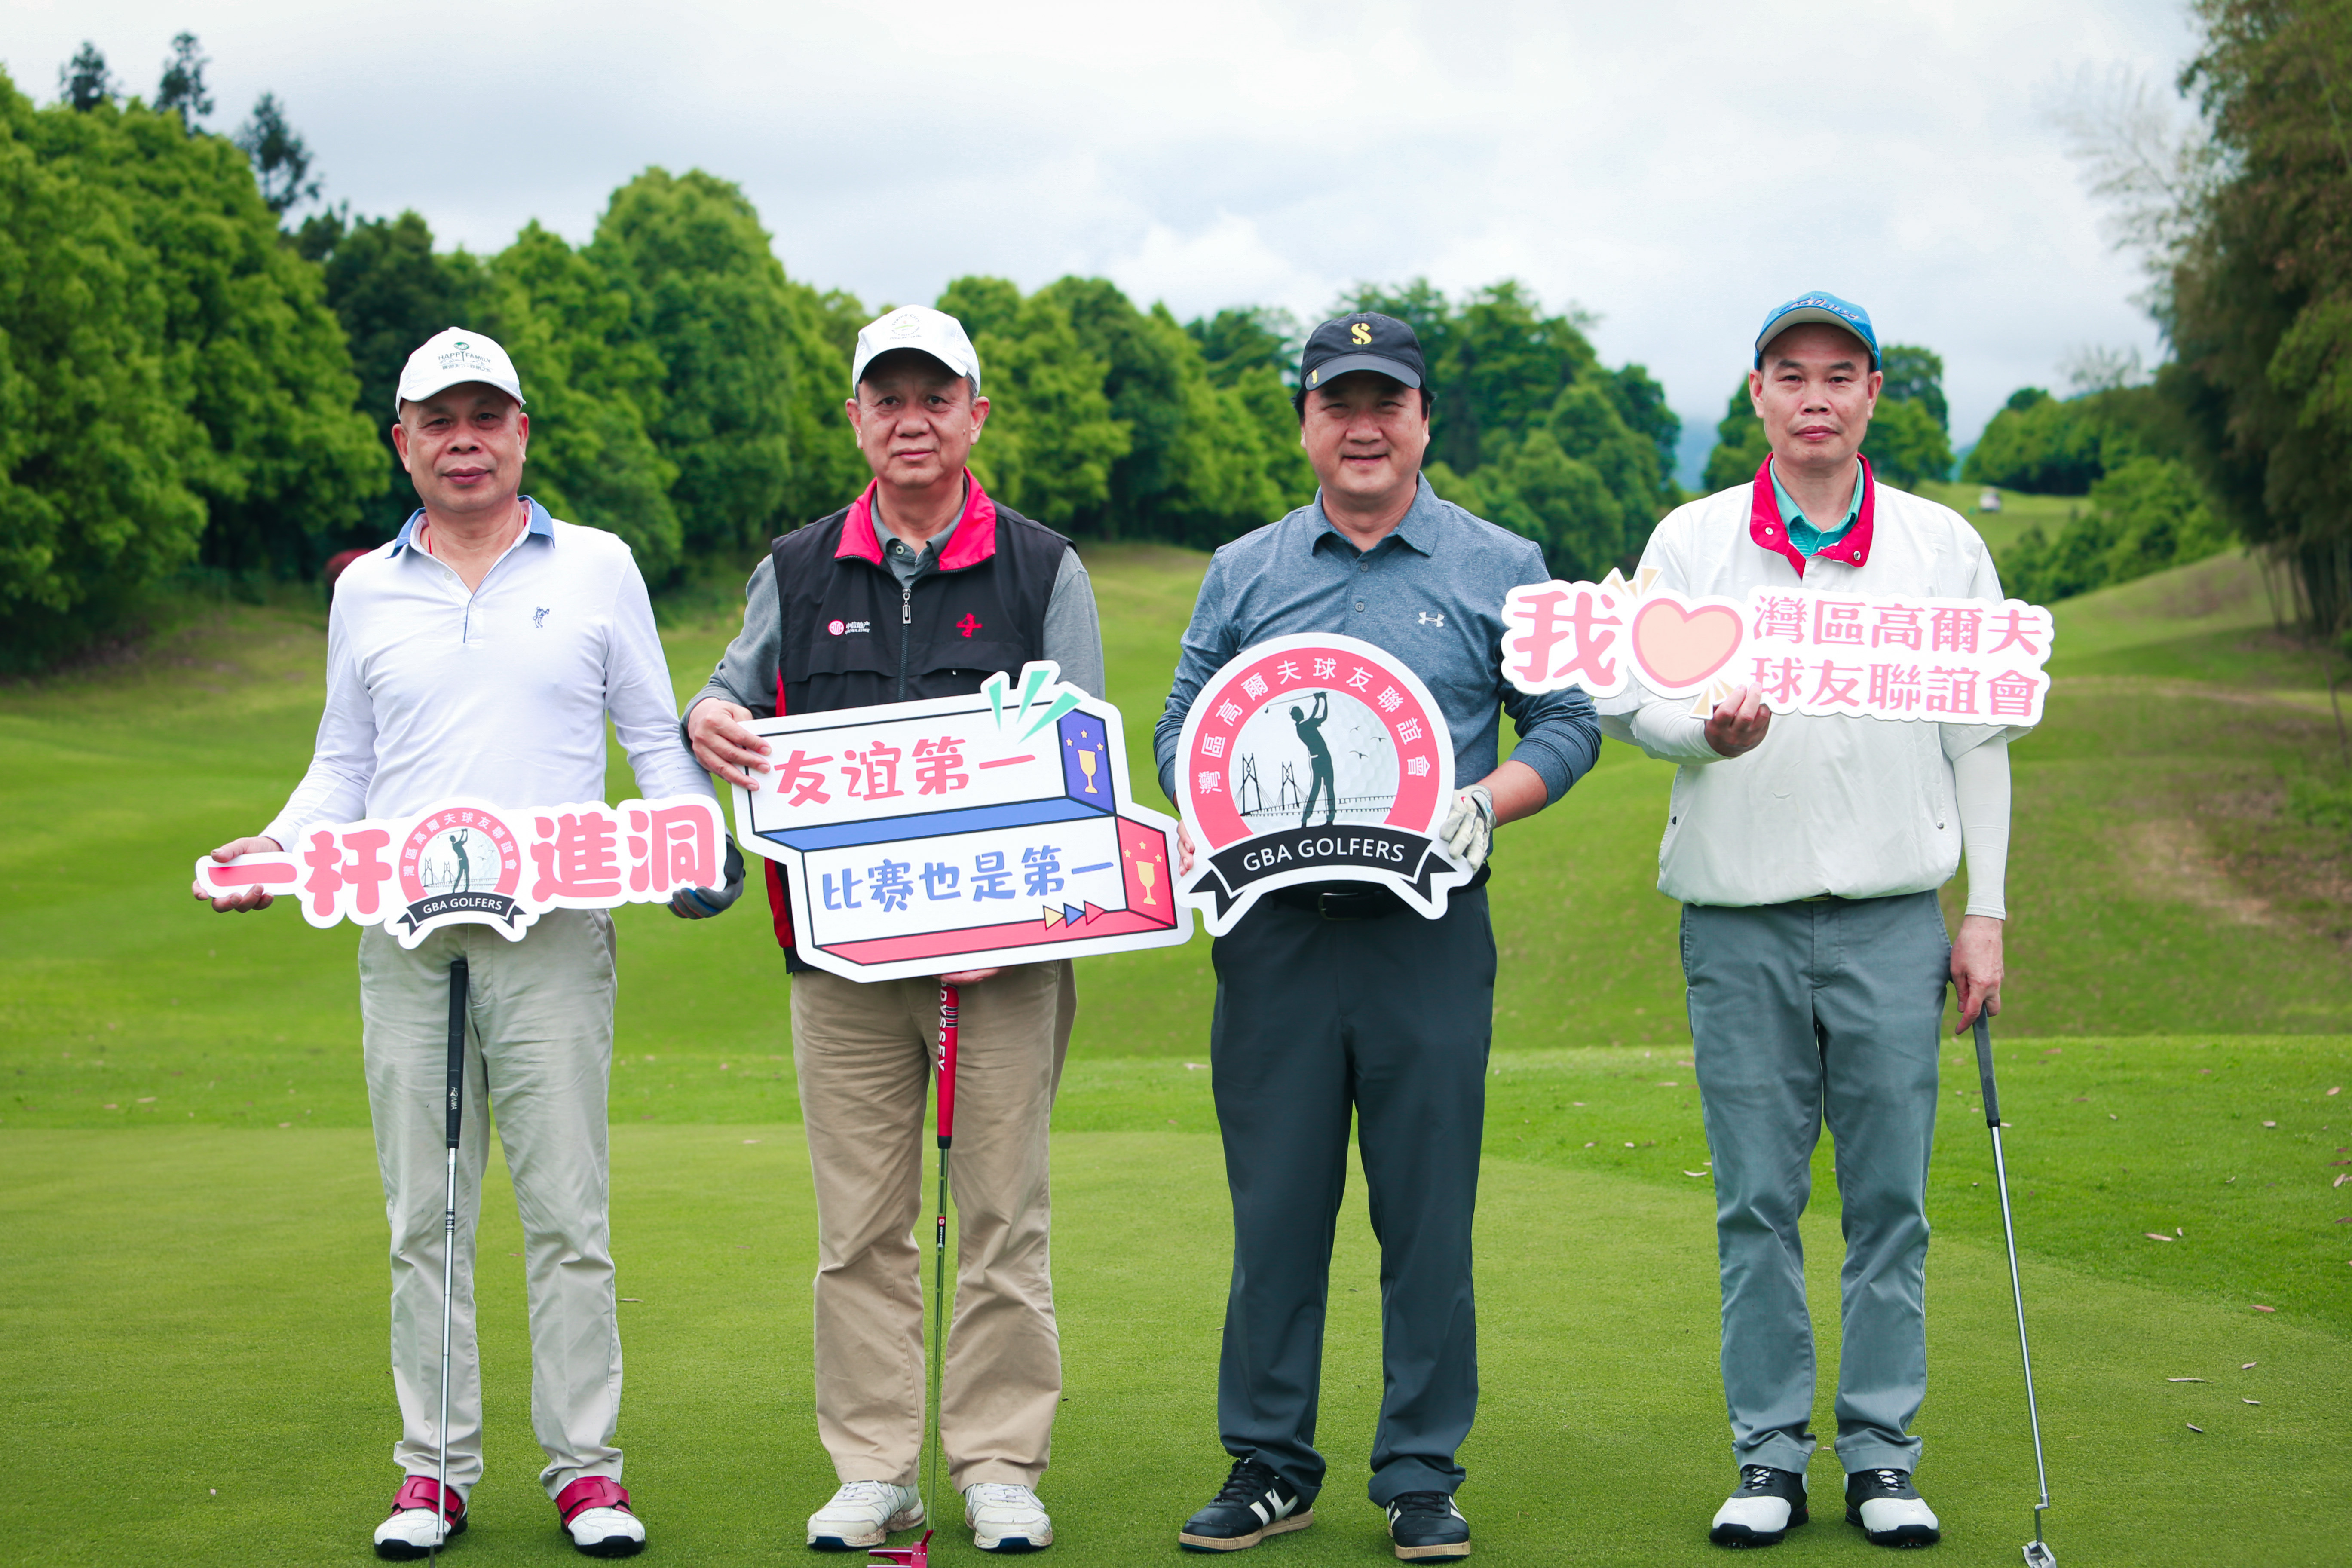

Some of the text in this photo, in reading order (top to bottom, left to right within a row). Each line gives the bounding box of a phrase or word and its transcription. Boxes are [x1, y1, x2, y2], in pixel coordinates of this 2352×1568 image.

[465, 352, 491, 363] FAMILY
[1513, 591, 1623, 686] 我
[1754, 595, 2042, 655] 灣區高爾夫
[1750, 657, 2040, 717] 球友聯誼會
[1198, 657, 1430, 794] 灣區高爾夫球友聯誼會
[774, 736, 1036, 807] 友谊第一
[403, 812, 517, 877] 灣區高爾夫球友聯誼會
[530, 805, 717, 903] 進洞
[1243, 837, 1405, 871] GBA GOLFERS
[423, 897, 502, 914] GBA GOLFERS
[822, 845, 1114, 913] 比赛也是第一
[450, 1087, 458, 1110] HONMA
